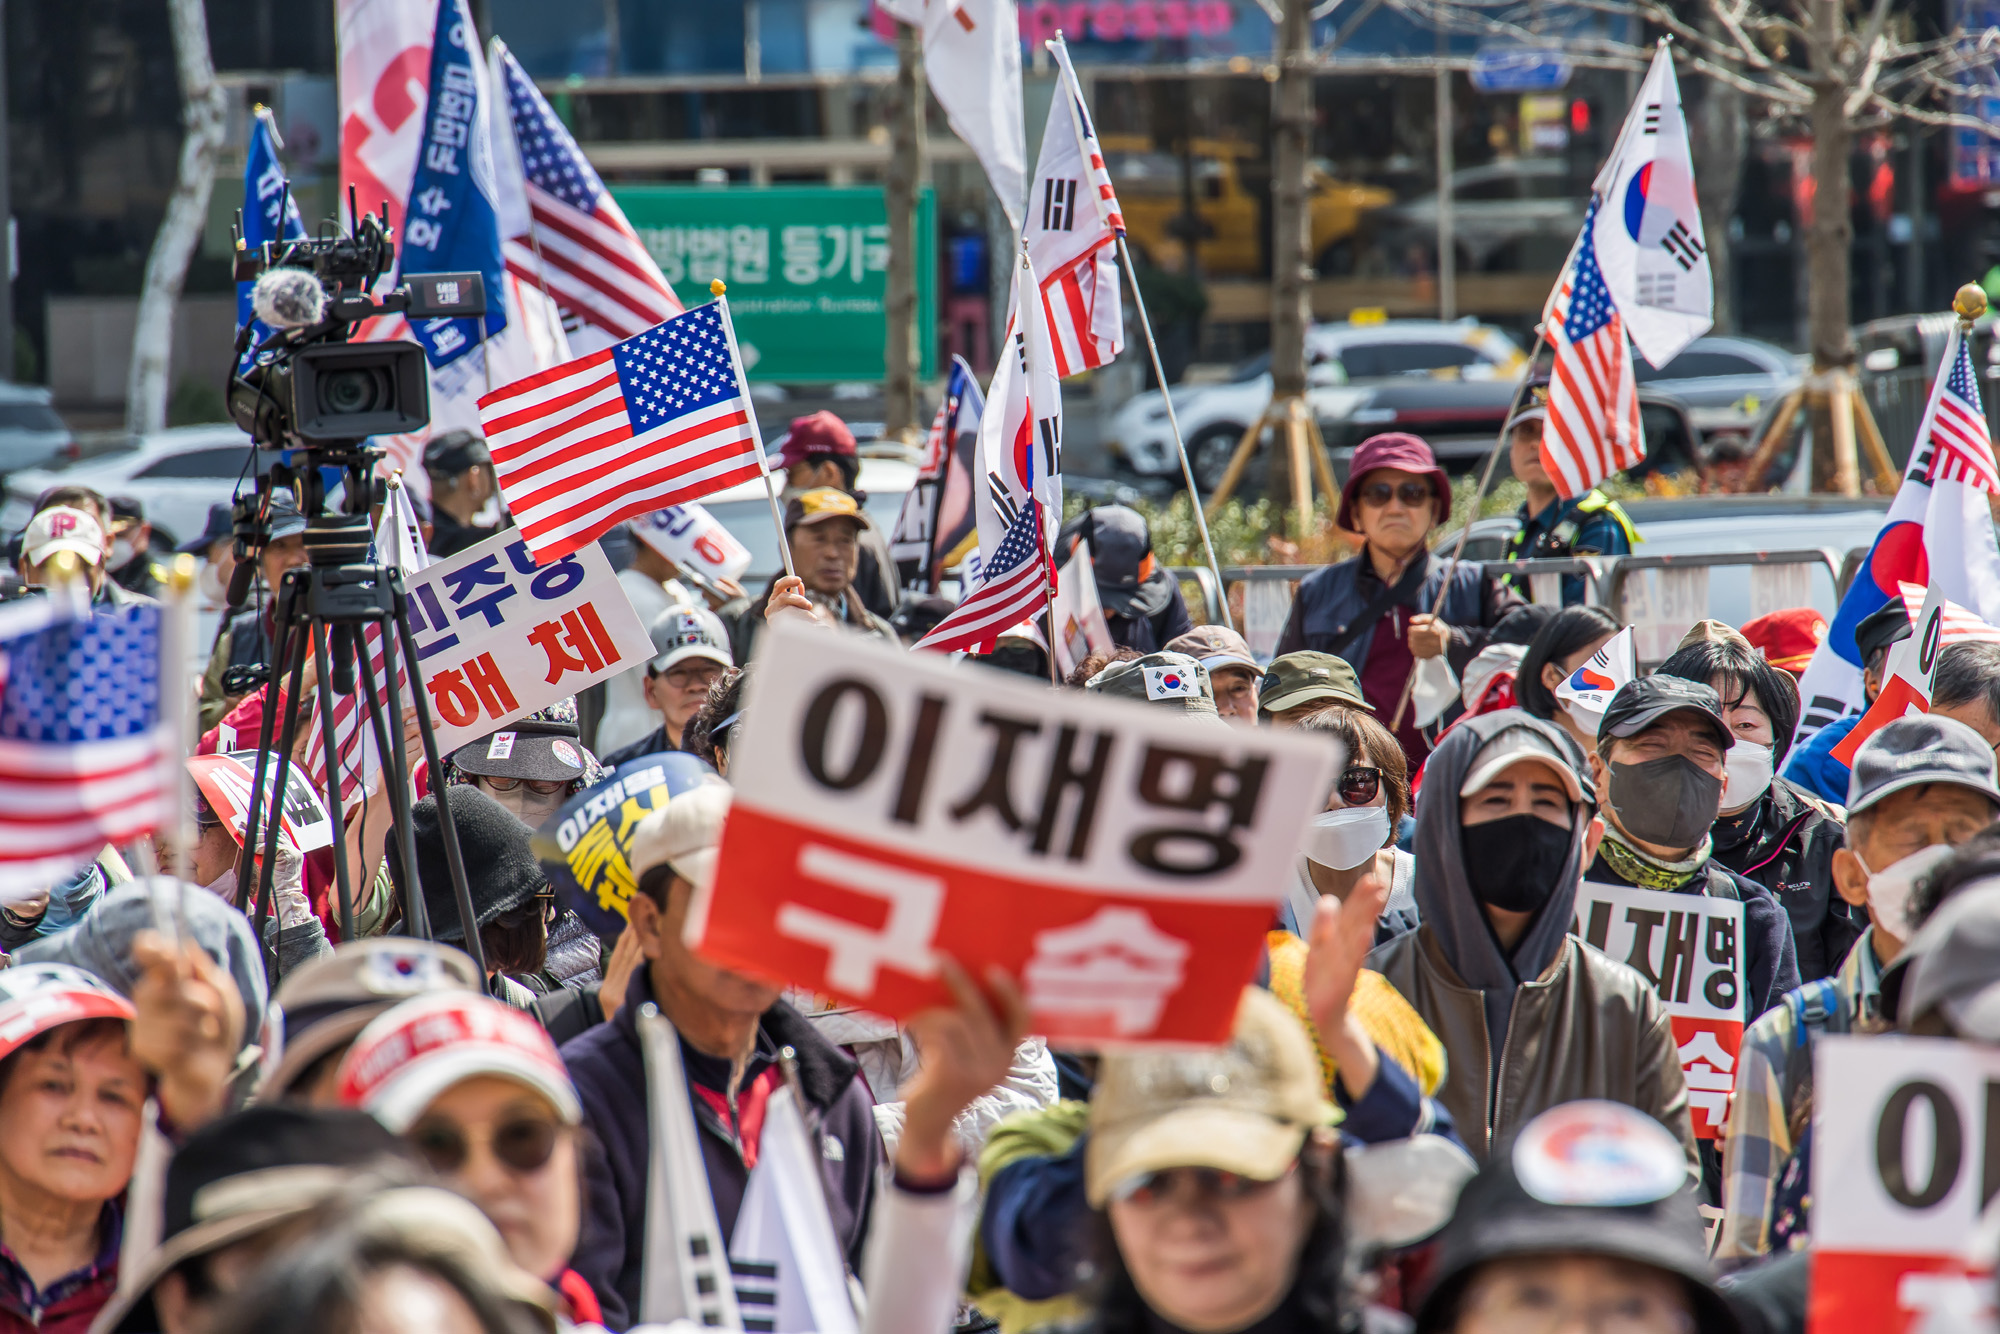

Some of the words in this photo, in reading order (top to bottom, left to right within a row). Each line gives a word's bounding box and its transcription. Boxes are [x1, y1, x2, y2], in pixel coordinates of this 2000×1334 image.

[640, 225, 769, 286] 방법원
[666, 632, 719, 650] SEOUL
[800, 676, 1269, 878] 이재명
